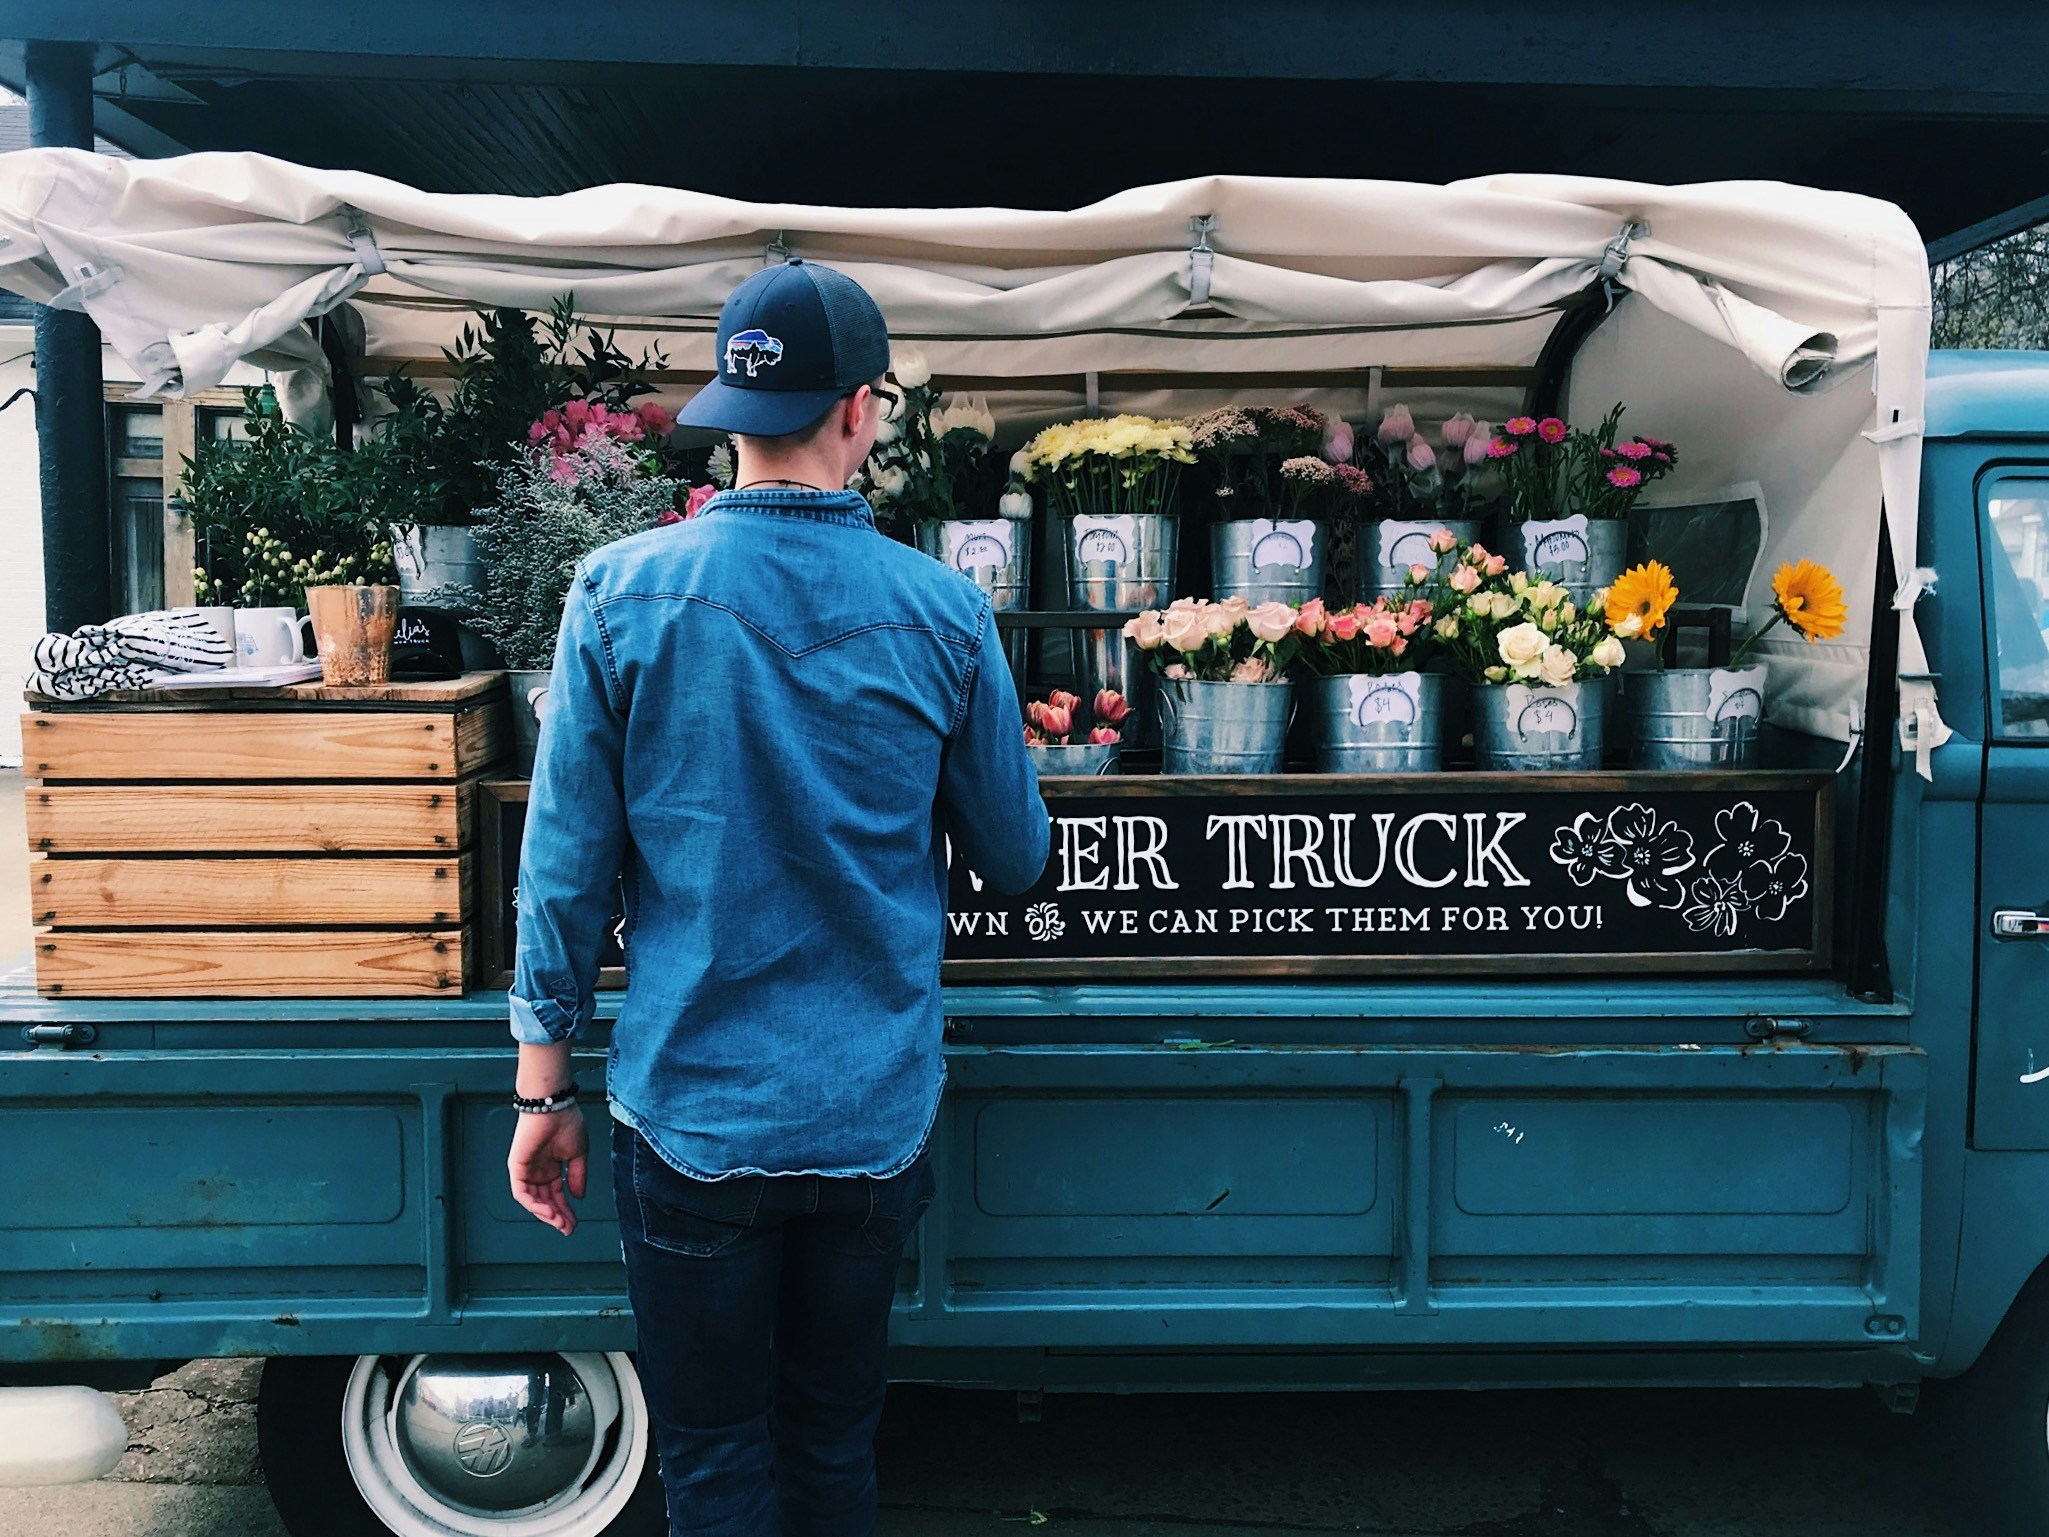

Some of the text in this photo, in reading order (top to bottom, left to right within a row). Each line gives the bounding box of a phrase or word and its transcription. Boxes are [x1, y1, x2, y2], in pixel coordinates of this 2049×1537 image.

[1375, 697, 1391, 714] $4
[1534, 709, 1553, 724] $4
[1206, 812, 1530, 889] TRUCK
[1081, 910, 1138, 934] WE
[1149, 909, 1219, 934] CAN
[1230, 908, 1314, 933] PICK
[1326, 907, 1431, 932] THEM
[1442, 906, 1510, 931] FOR
[1521, 905, 1603, 930] YOU!
